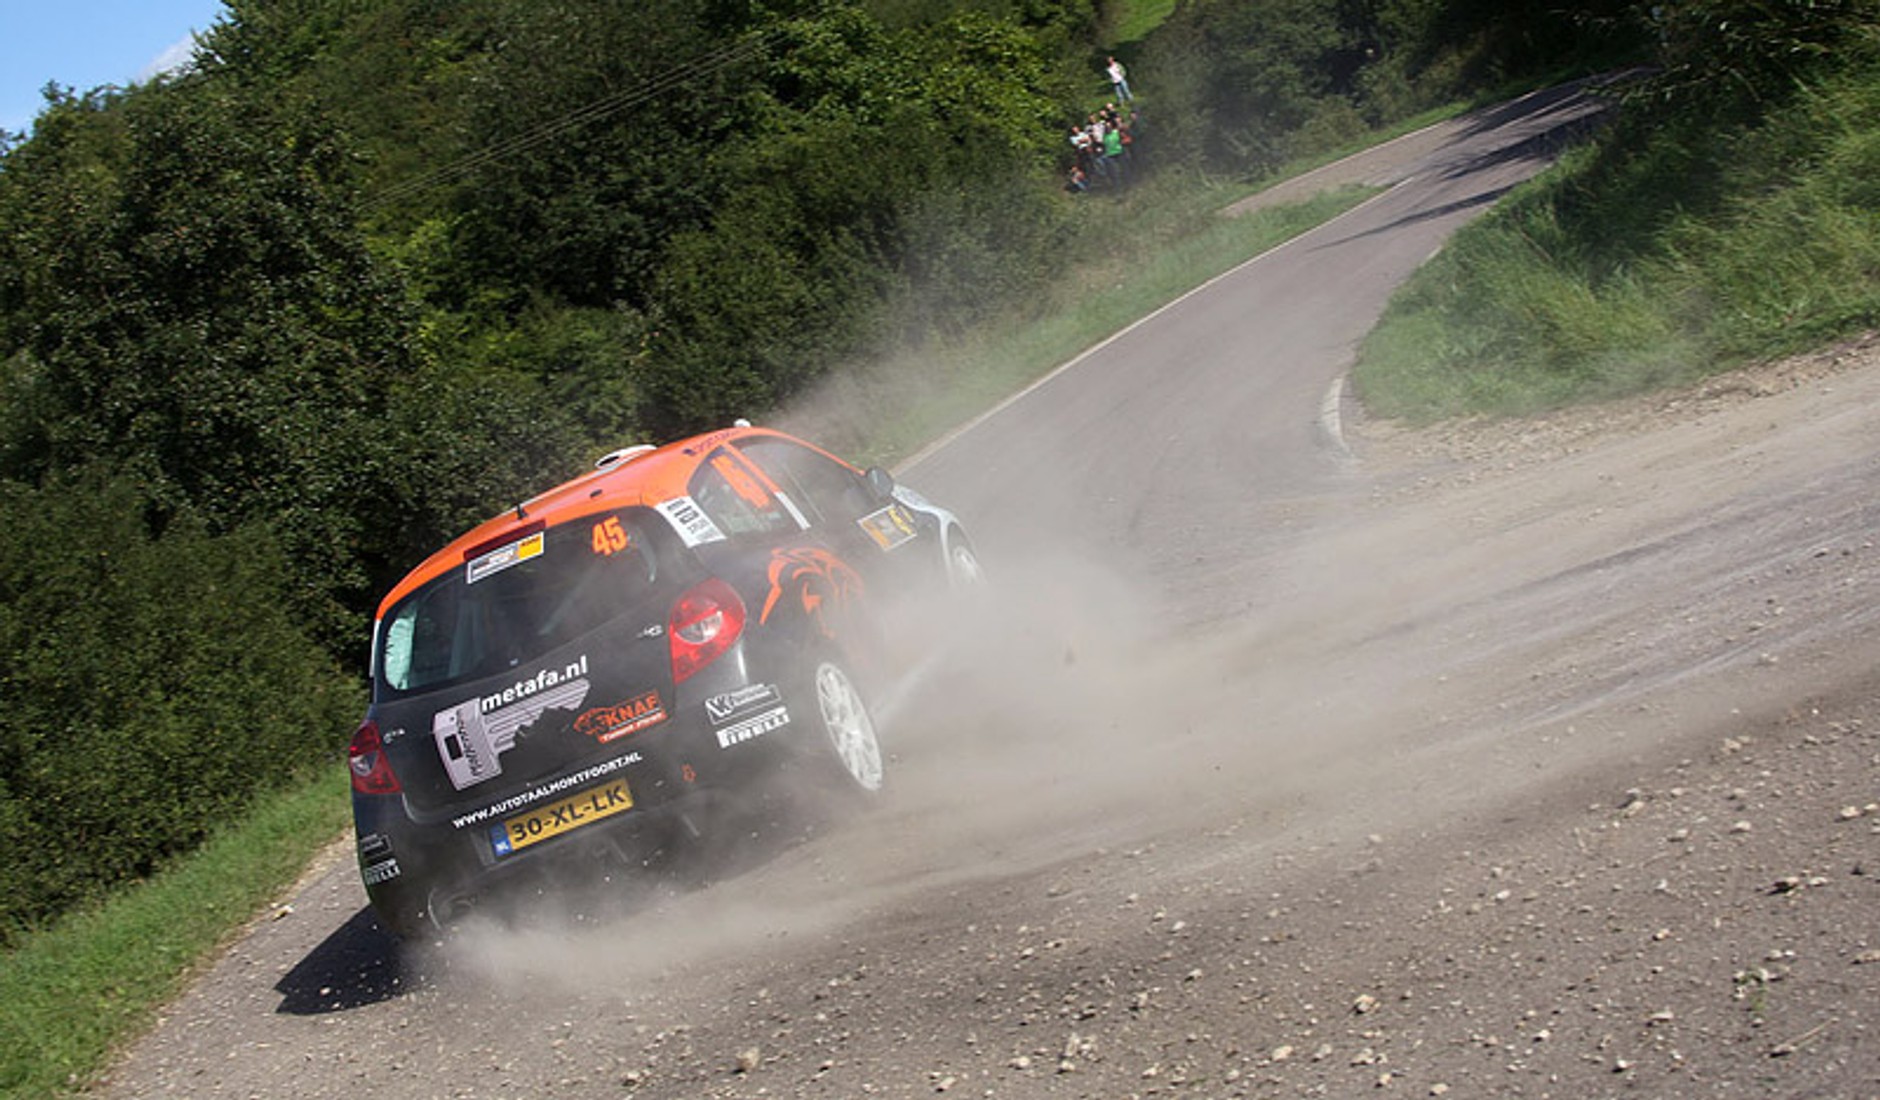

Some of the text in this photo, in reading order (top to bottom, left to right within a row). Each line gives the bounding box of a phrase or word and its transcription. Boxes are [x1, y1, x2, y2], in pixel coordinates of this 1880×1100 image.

[592, 515, 628, 556] 45
[481, 655, 588, 713] metafa.nl
[604, 694, 660, 726] KNAF
[716, 706, 790, 748] PIRELLI
[453, 751, 643, 829] WWW.AUTOTAALMONTFOORT.NL
[512, 785, 626, 843] 30-XL-LK
